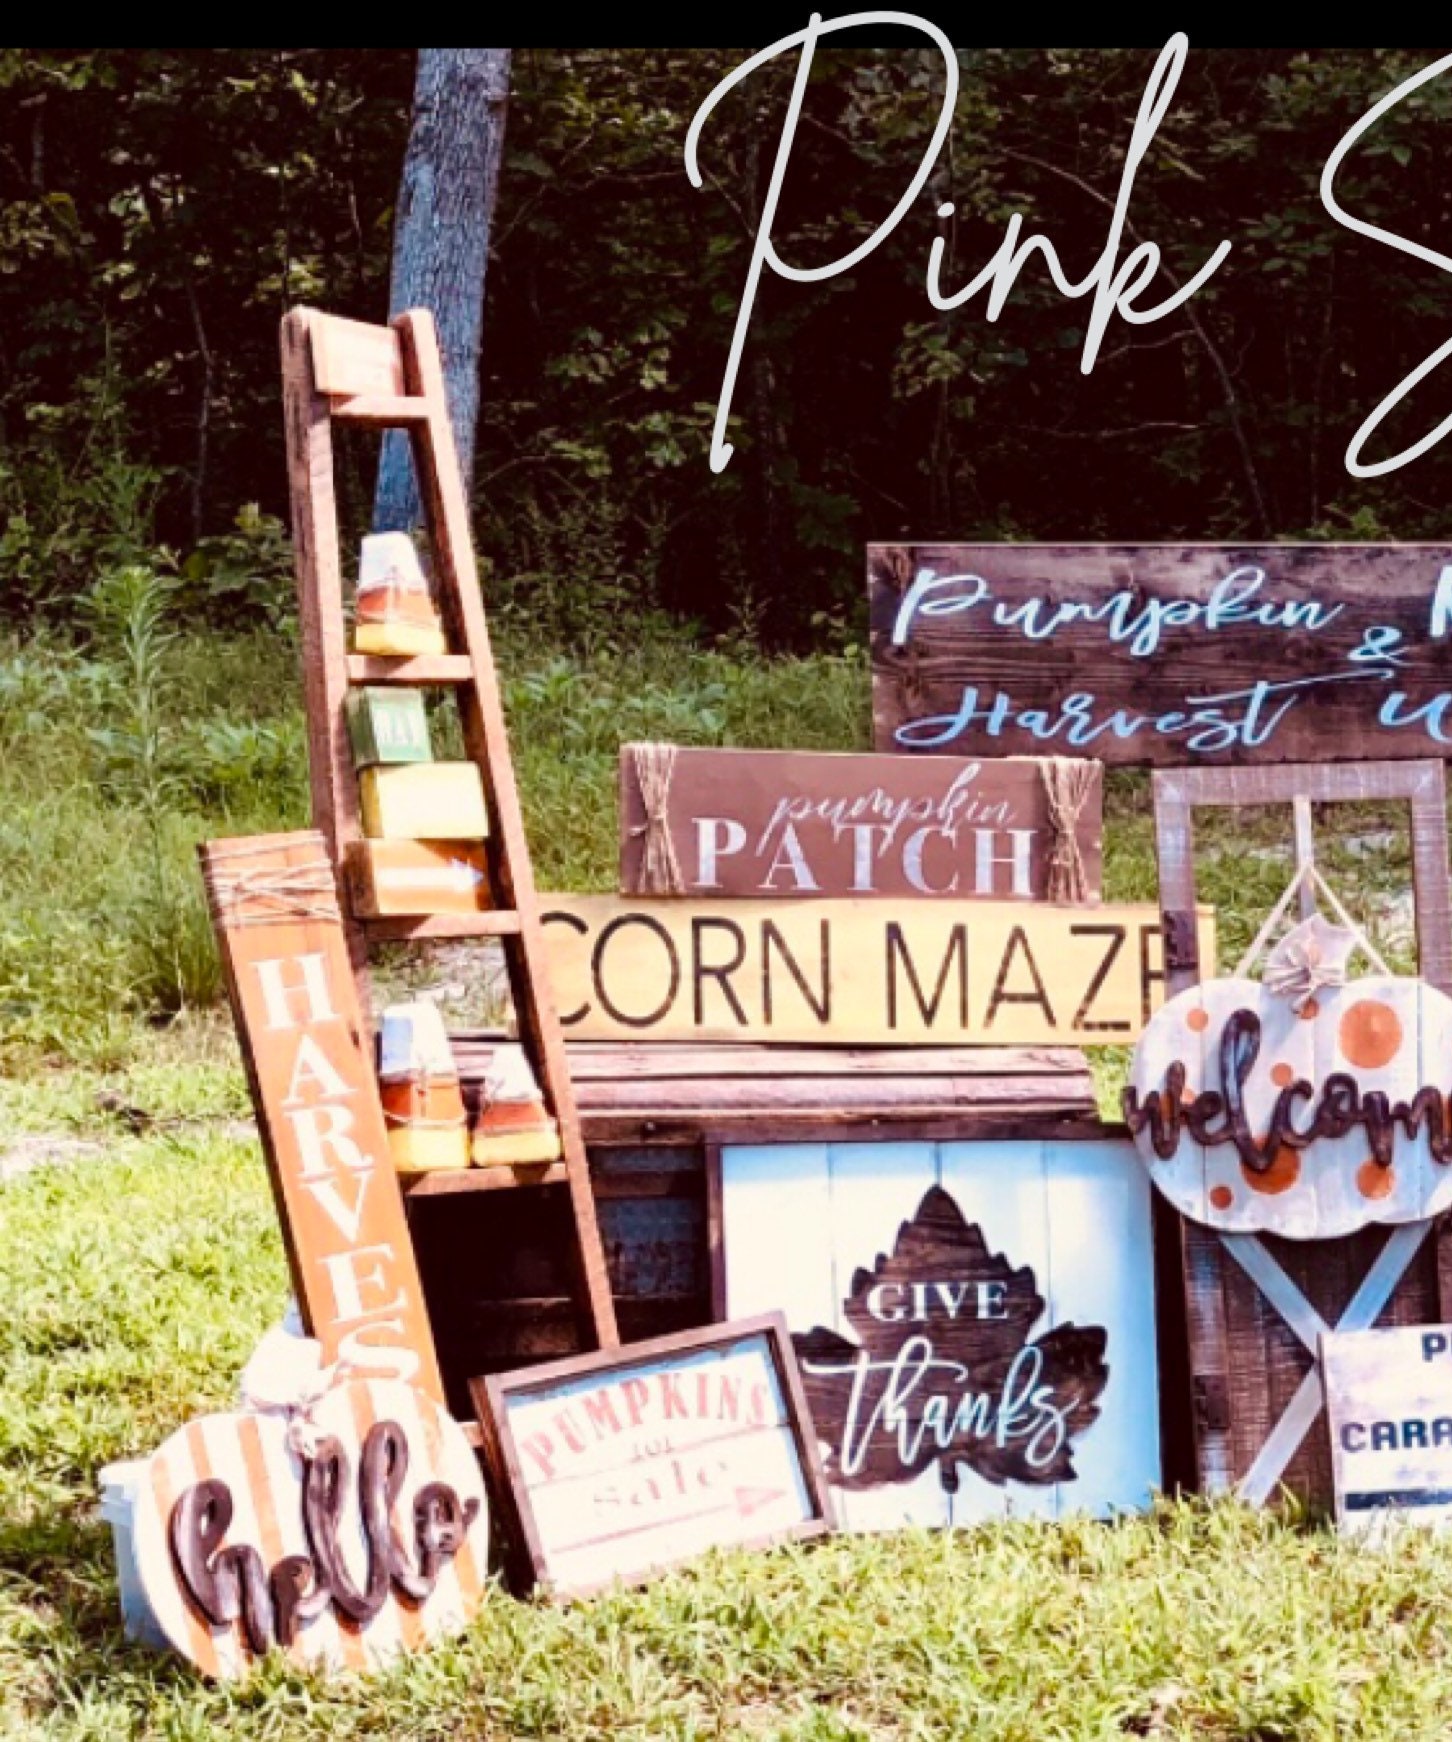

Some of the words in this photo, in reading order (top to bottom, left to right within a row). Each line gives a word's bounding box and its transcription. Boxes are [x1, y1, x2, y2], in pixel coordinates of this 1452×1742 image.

[891, 565, 1346, 657] Pumpkin
[1348, 625, 1409, 664] &
[895, 667, 1395, 752] Harvest
[690, 816, 1038, 897] PATCH
[755, 762, 1019, 858] pumpkin
[540, 911, 832, 1028] CORN
[248, 950, 421, 1384] HARVES
[866, 1281, 1011, 1322] GIVE
[521, 1371, 768, 1480] PUMPKINS
[169, 1419, 482, 1656] hello
